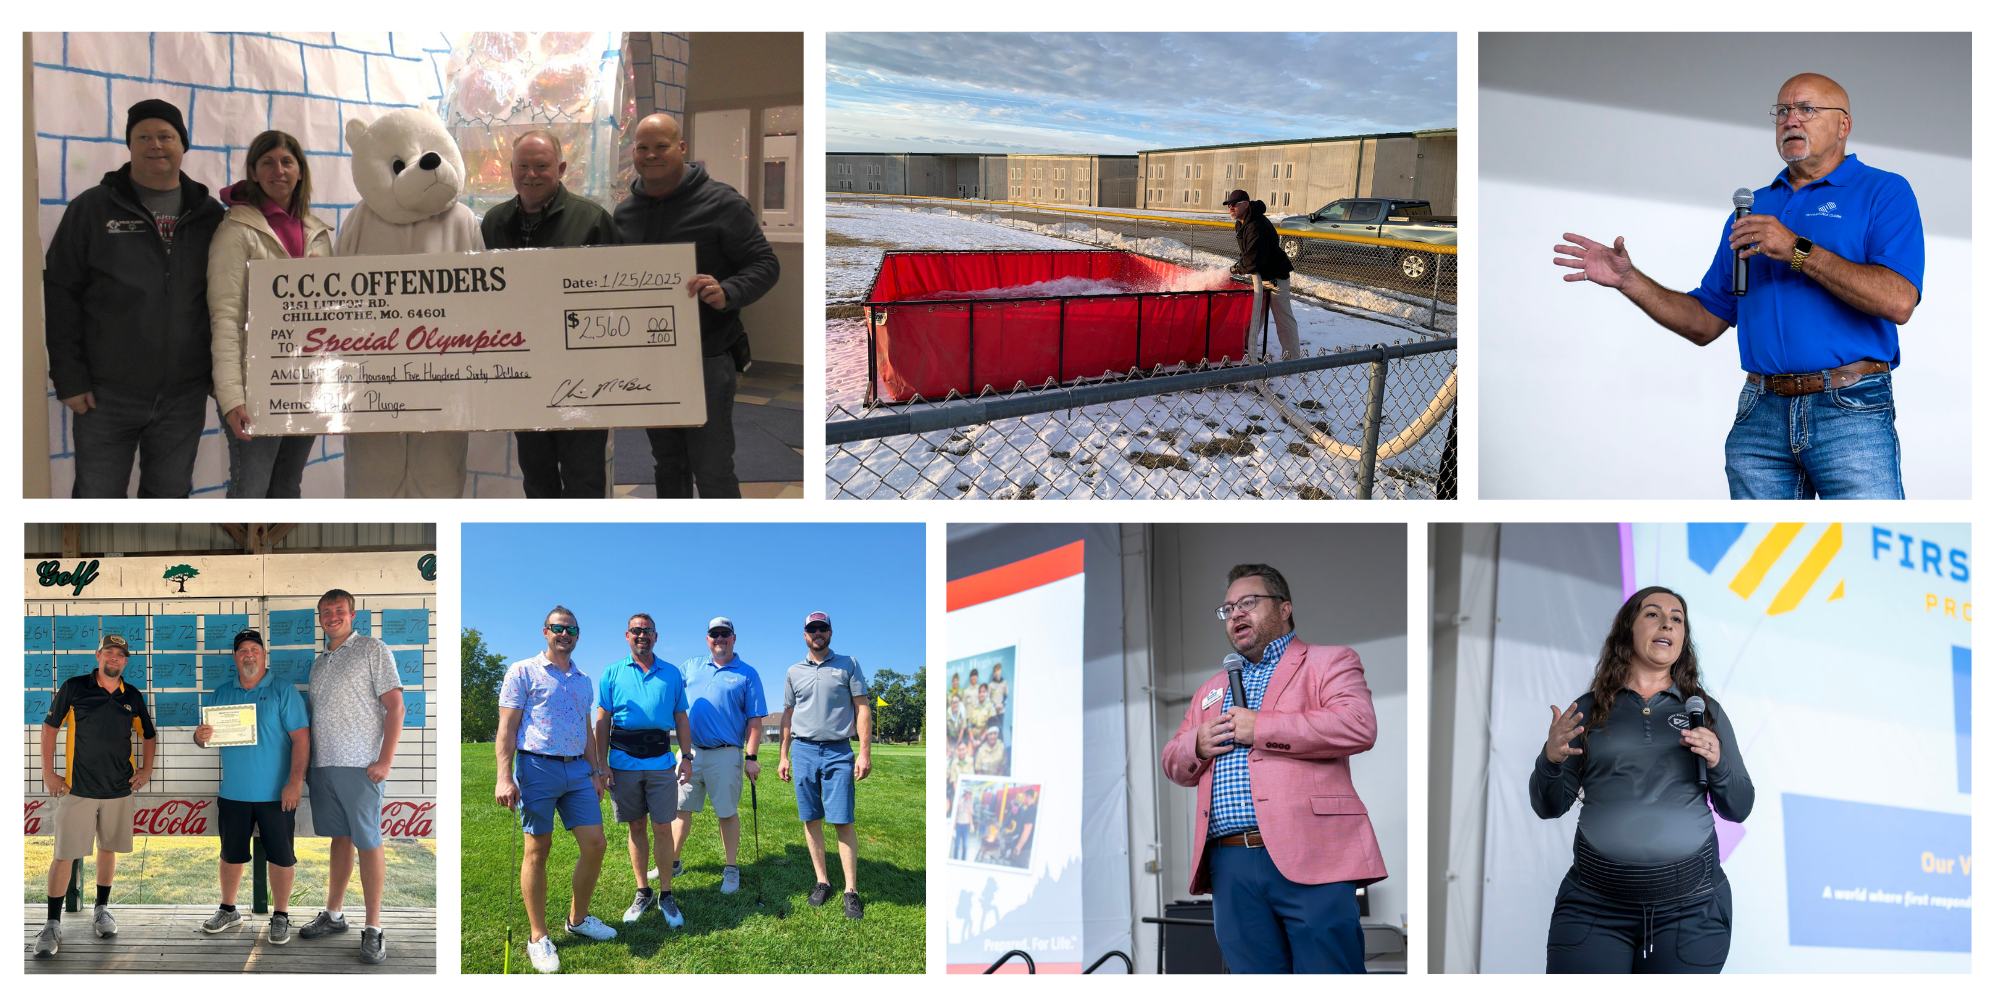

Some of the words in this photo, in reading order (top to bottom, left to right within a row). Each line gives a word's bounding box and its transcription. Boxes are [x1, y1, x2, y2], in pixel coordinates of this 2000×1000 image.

[351, 267, 506, 297] OFFENDERS
[563, 278, 598, 289] Date:
[600, 271, 682, 289] 1/25/2025
[283, 301, 309, 310] 3151
[314, 299, 363, 310] LITTON
[368, 299, 389, 308] RD.
[283, 310, 376, 322] CHILLICOTHE,
[380, 309, 402, 319] MO.
[407, 308, 446, 318] 64601
[271, 329, 294, 340] PAY
[302, 327, 400, 357] Special
[406, 325, 526, 355] Olympics
[354, 360, 397, 384] Thousand
[404, 362, 420, 380] Five
[424, 362, 460, 382] Hundred
[466, 365, 488, 383] Sixty
[364, 390, 405, 418] Plunge
[1872, 525, 1970, 583] FIRS
[36, 560, 99, 596] Golf
[34, 626, 48, 640] 64
[81, 624, 95, 638] 64
[129, 626, 143, 641] 61
[178, 625, 194, 640] 72
[296, 619, 313, 635] 65
[409, 618, 427, 634] 70
[34, 663, 51, 677] 65
[129, 664, 145, 679] 65
[178, 663, 194, 677] 71
[404, 660, 420, 674] 62
[181, 702, 196, 716] 56
[406, 702, 423, 716] 62
[1921, 852, 1956, 875] Our
[1822, 885, 1833, 899] A
[1834, 887, 1868, 902] world
[1868, 889, 1903, 904] where
[1904, 891, 1929, 908] first
[983, 937, 1031, 954] Prepared.
[1031, 936, 1049, 951] For
